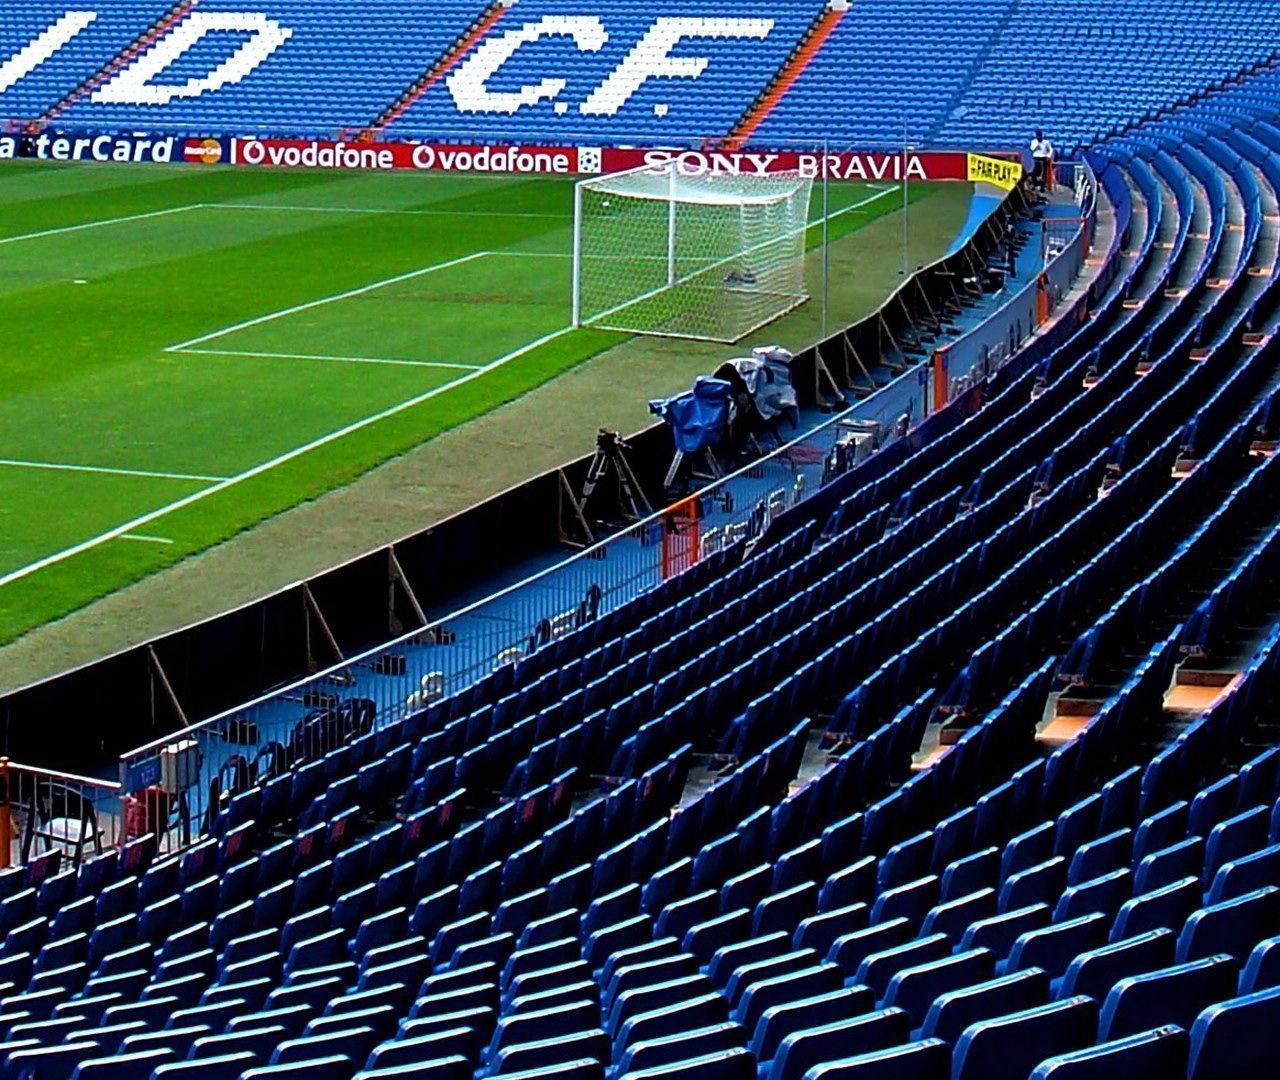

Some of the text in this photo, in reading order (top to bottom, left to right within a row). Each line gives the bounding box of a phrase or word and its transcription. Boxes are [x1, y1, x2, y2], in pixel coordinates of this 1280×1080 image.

[267, 141, 394, 168] vodafone
[438, 145, 569, 173] vodafone
[643, 151, 927, 180] SONY BRAVIA
